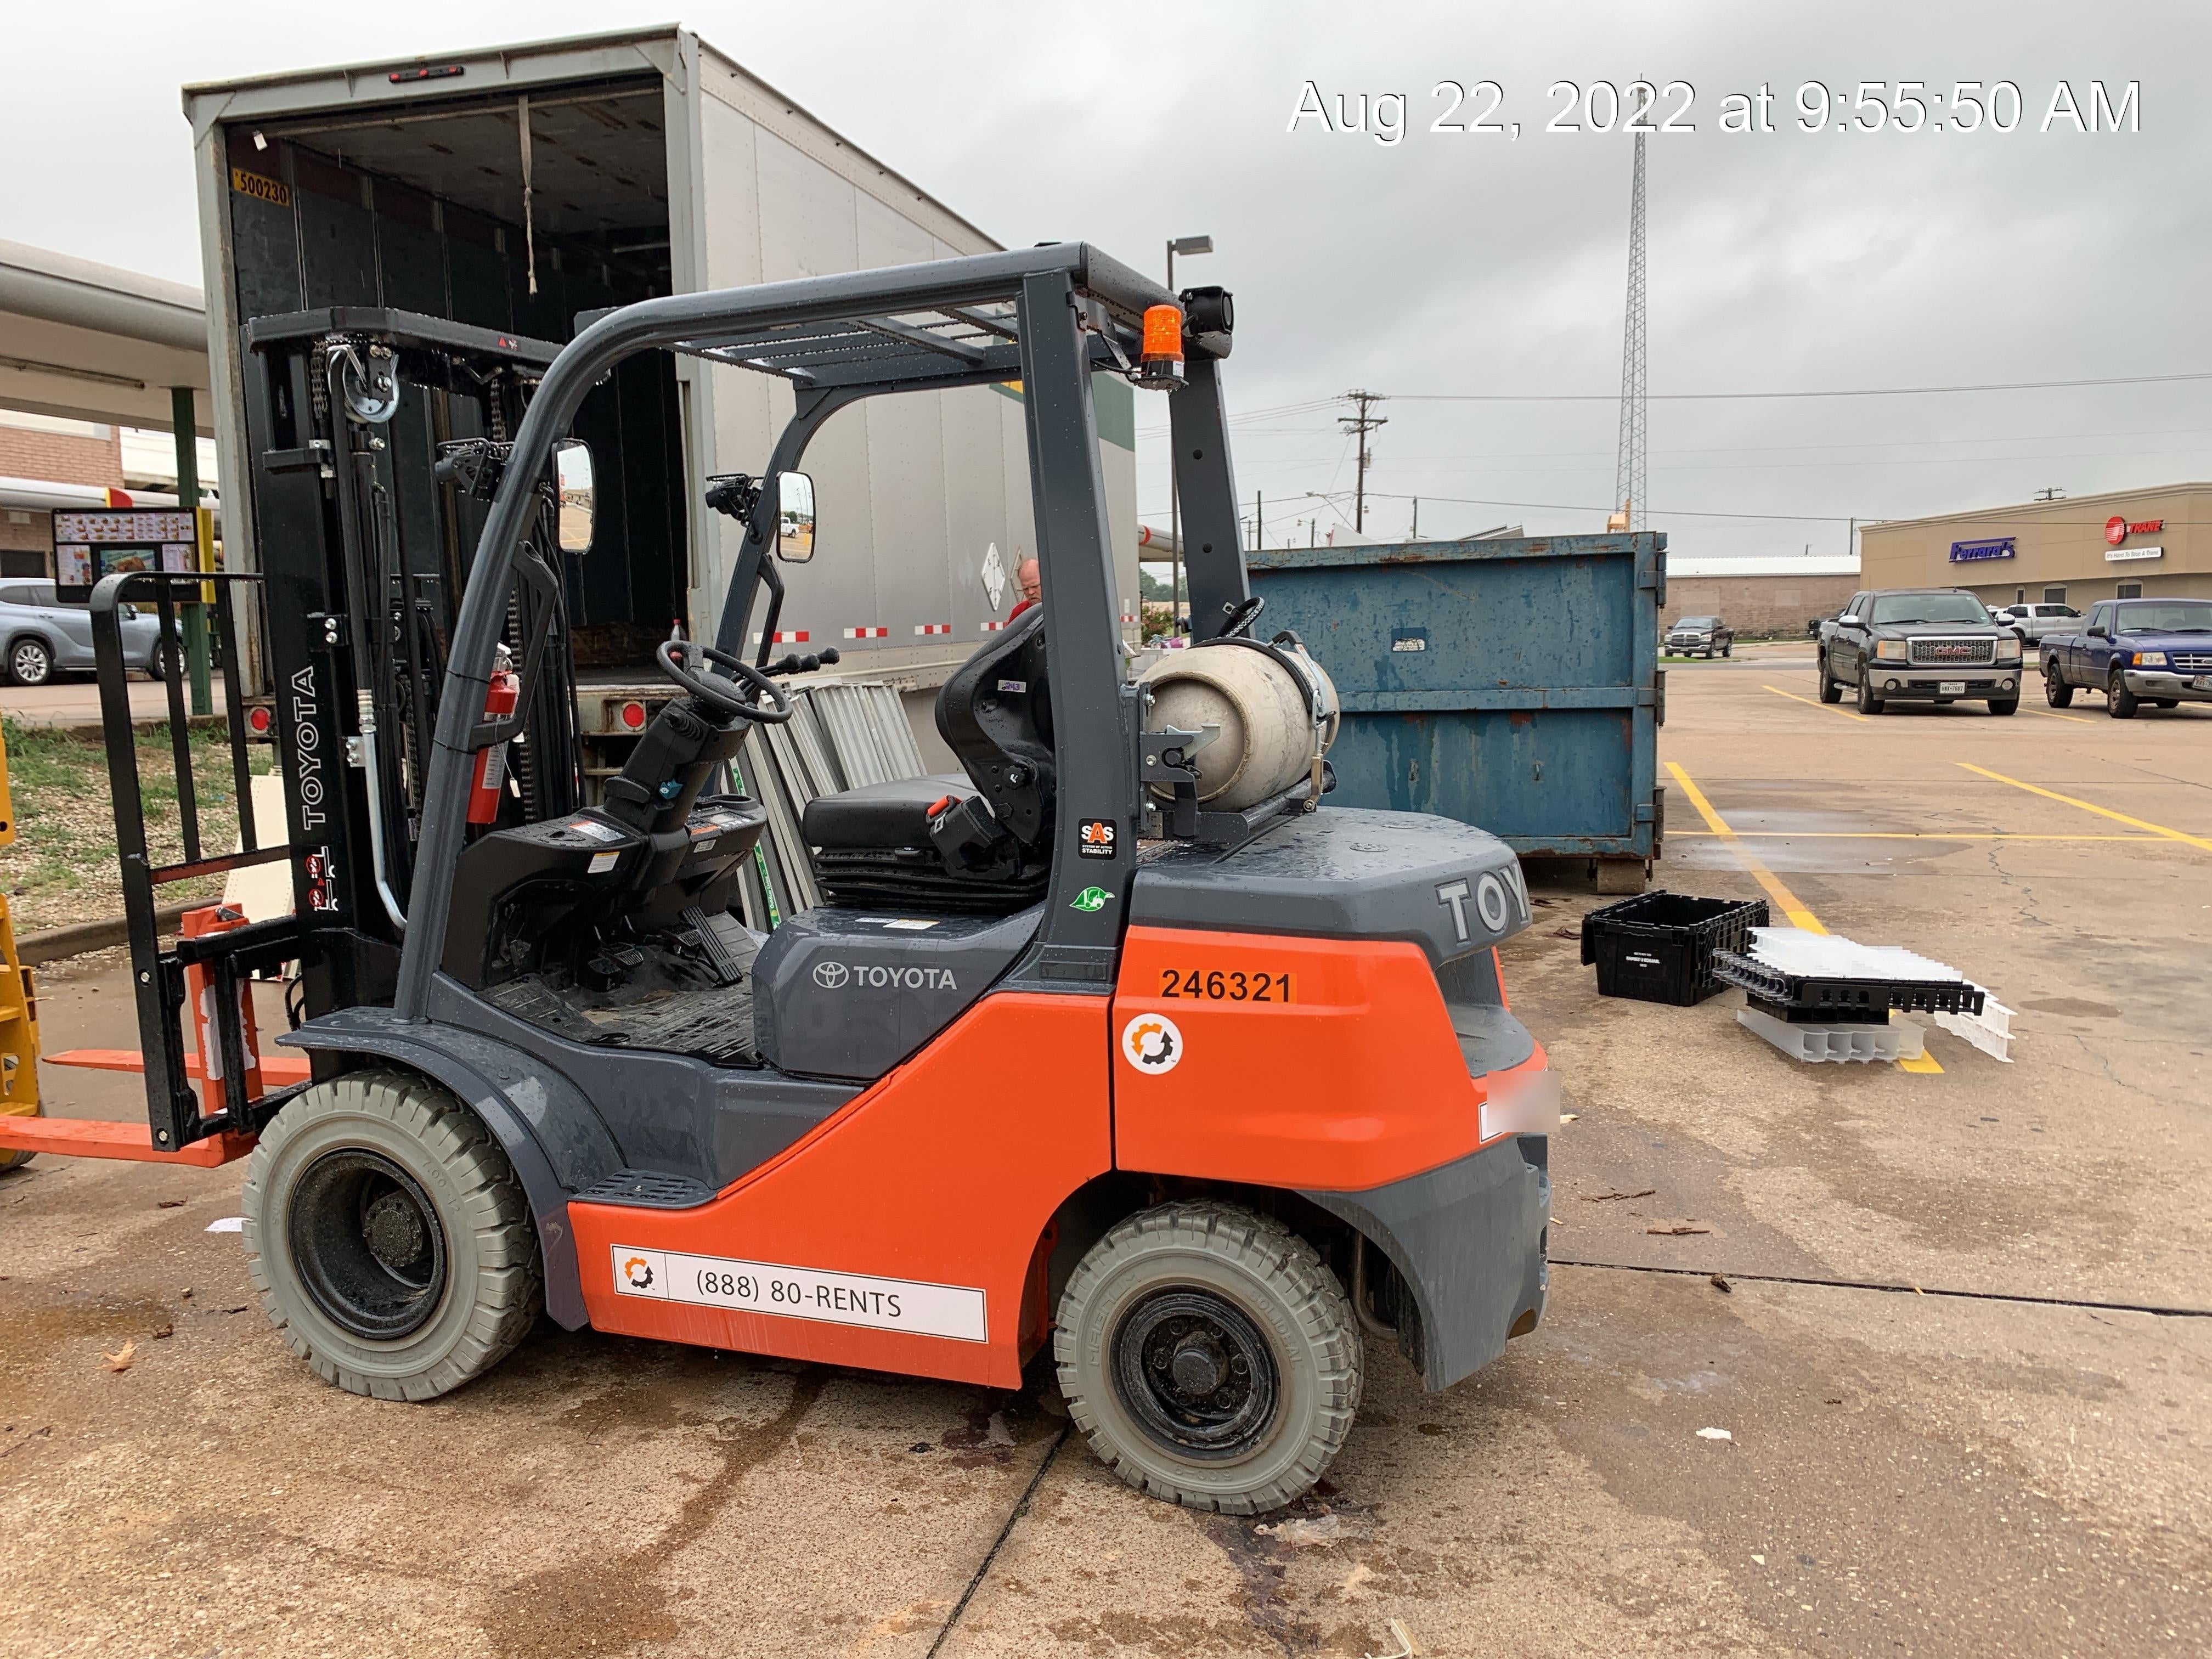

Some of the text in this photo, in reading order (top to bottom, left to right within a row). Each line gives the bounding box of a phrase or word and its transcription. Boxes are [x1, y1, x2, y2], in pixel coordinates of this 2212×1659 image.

[240, 173, 287, 204] 500230
[2129, 520, 2162, 534] TRANE
[1935, 646, 1972, 655] GMC
[291, 665, 325, 831] TOYOTA
[1081, 822, 1114, 844] SAS
[854, 966, 957, 990] TOYOTA
[1161, 969, 1289, 1003] 246321
[697, 1269, 901, 1317] (888) 80-RENTS
